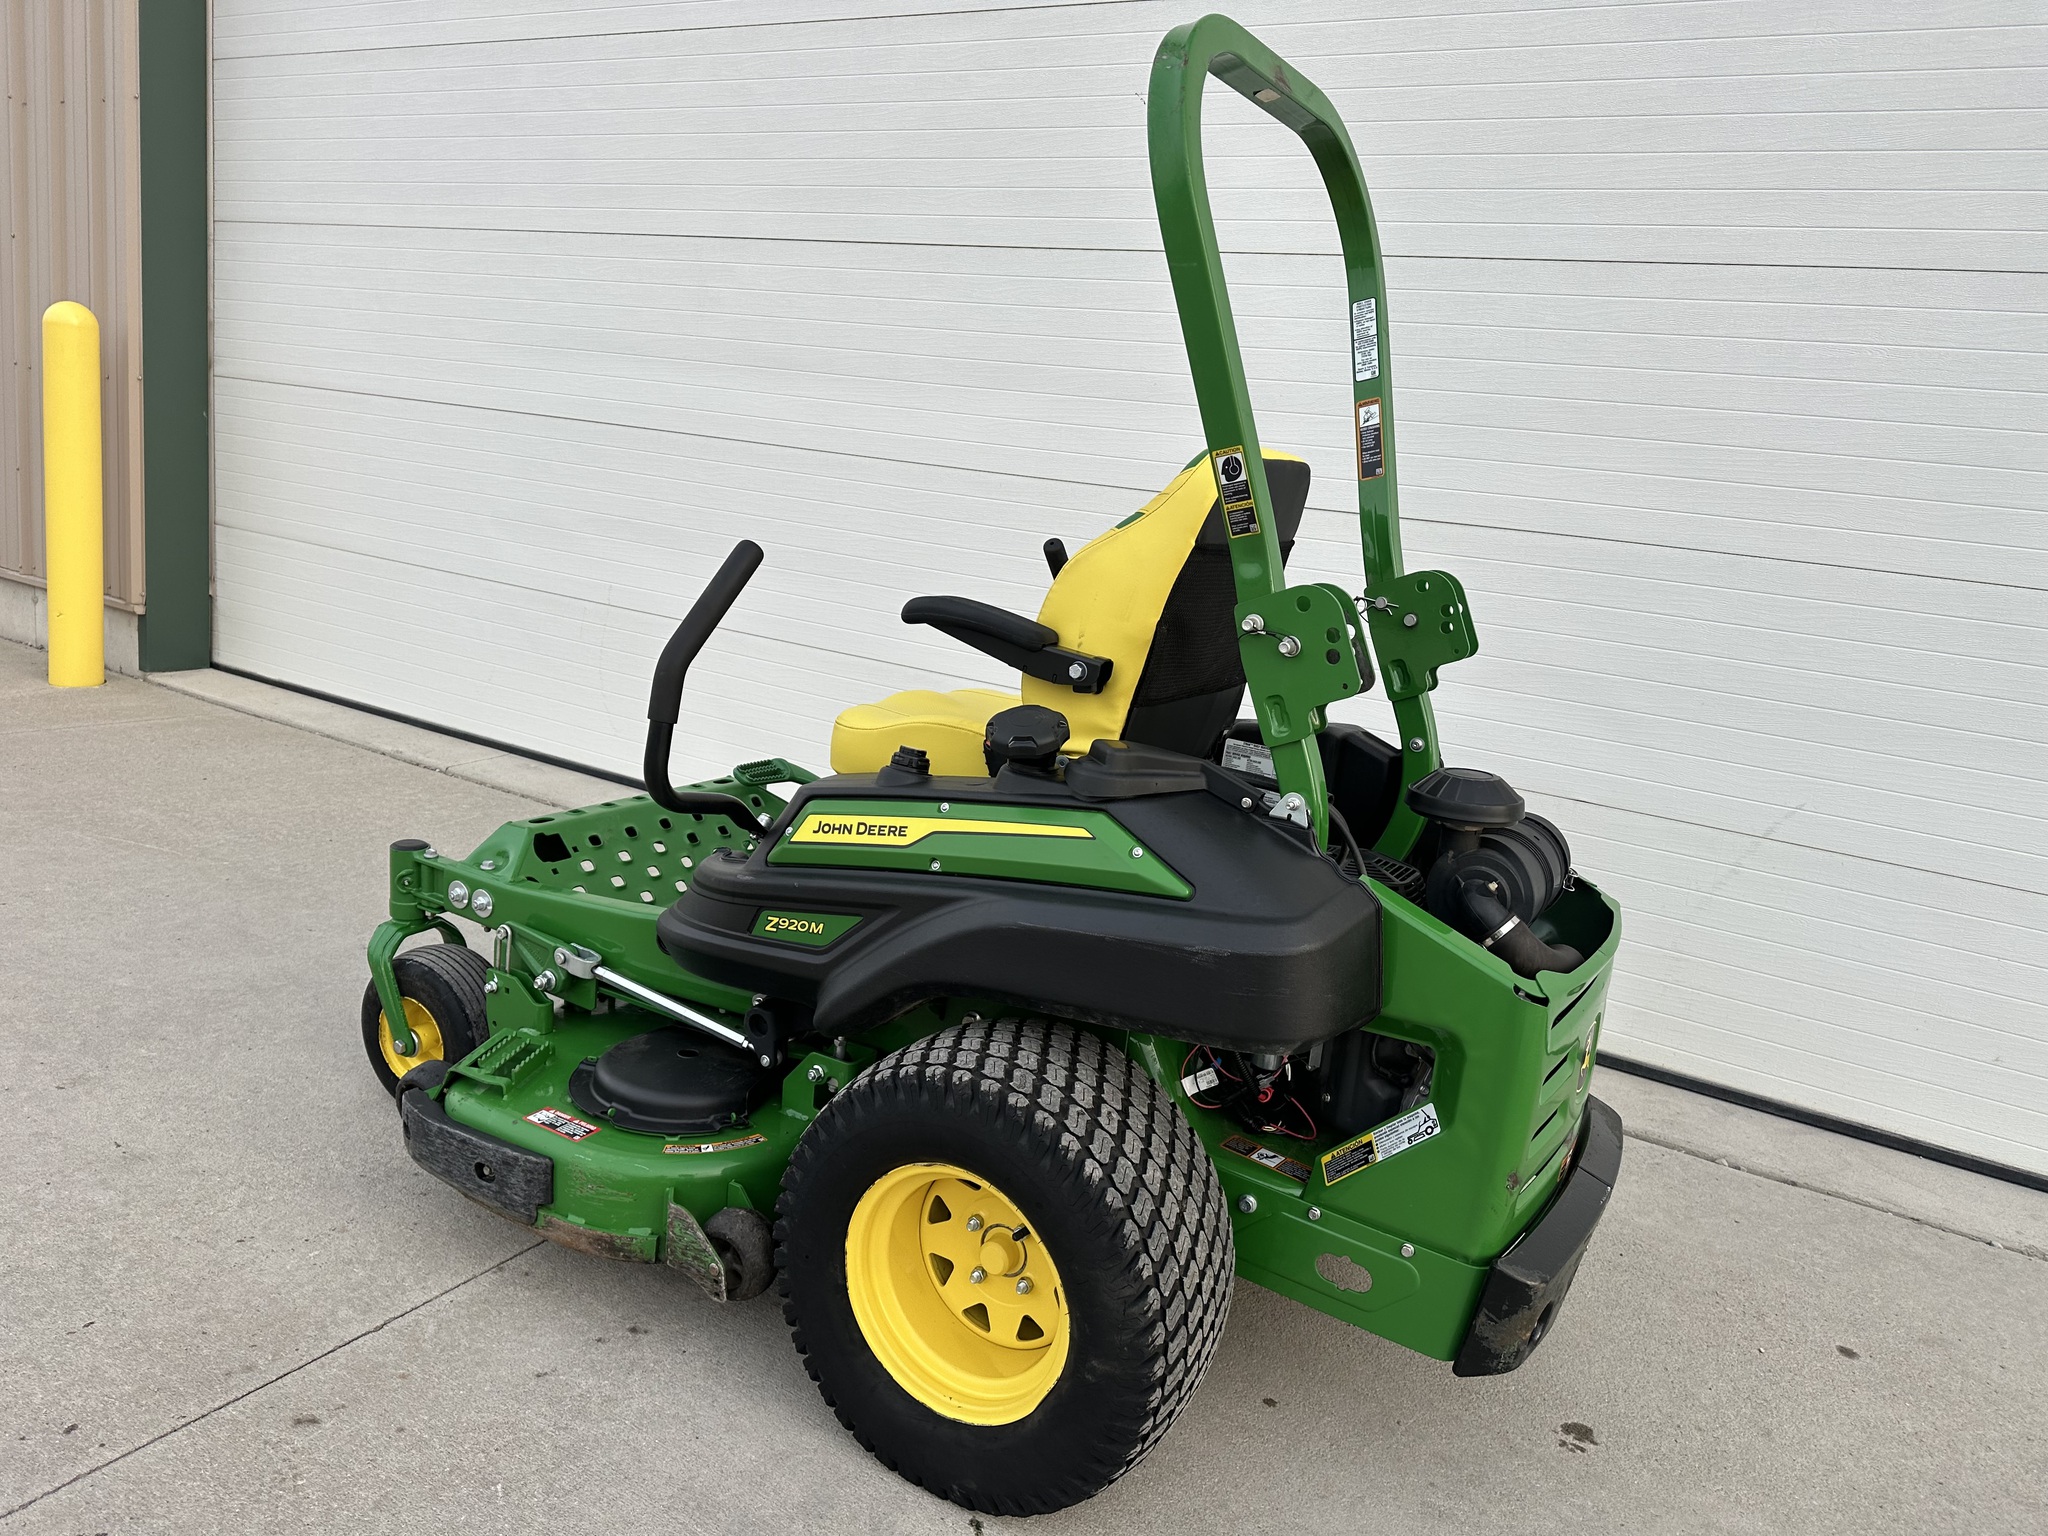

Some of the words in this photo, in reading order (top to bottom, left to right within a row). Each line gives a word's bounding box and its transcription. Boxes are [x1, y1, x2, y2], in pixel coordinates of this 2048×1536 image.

[812, 820, 853, 835] JOHN
[856, 821, 908, 837] DEERE
[764, 915, 825, 935] Z920M
